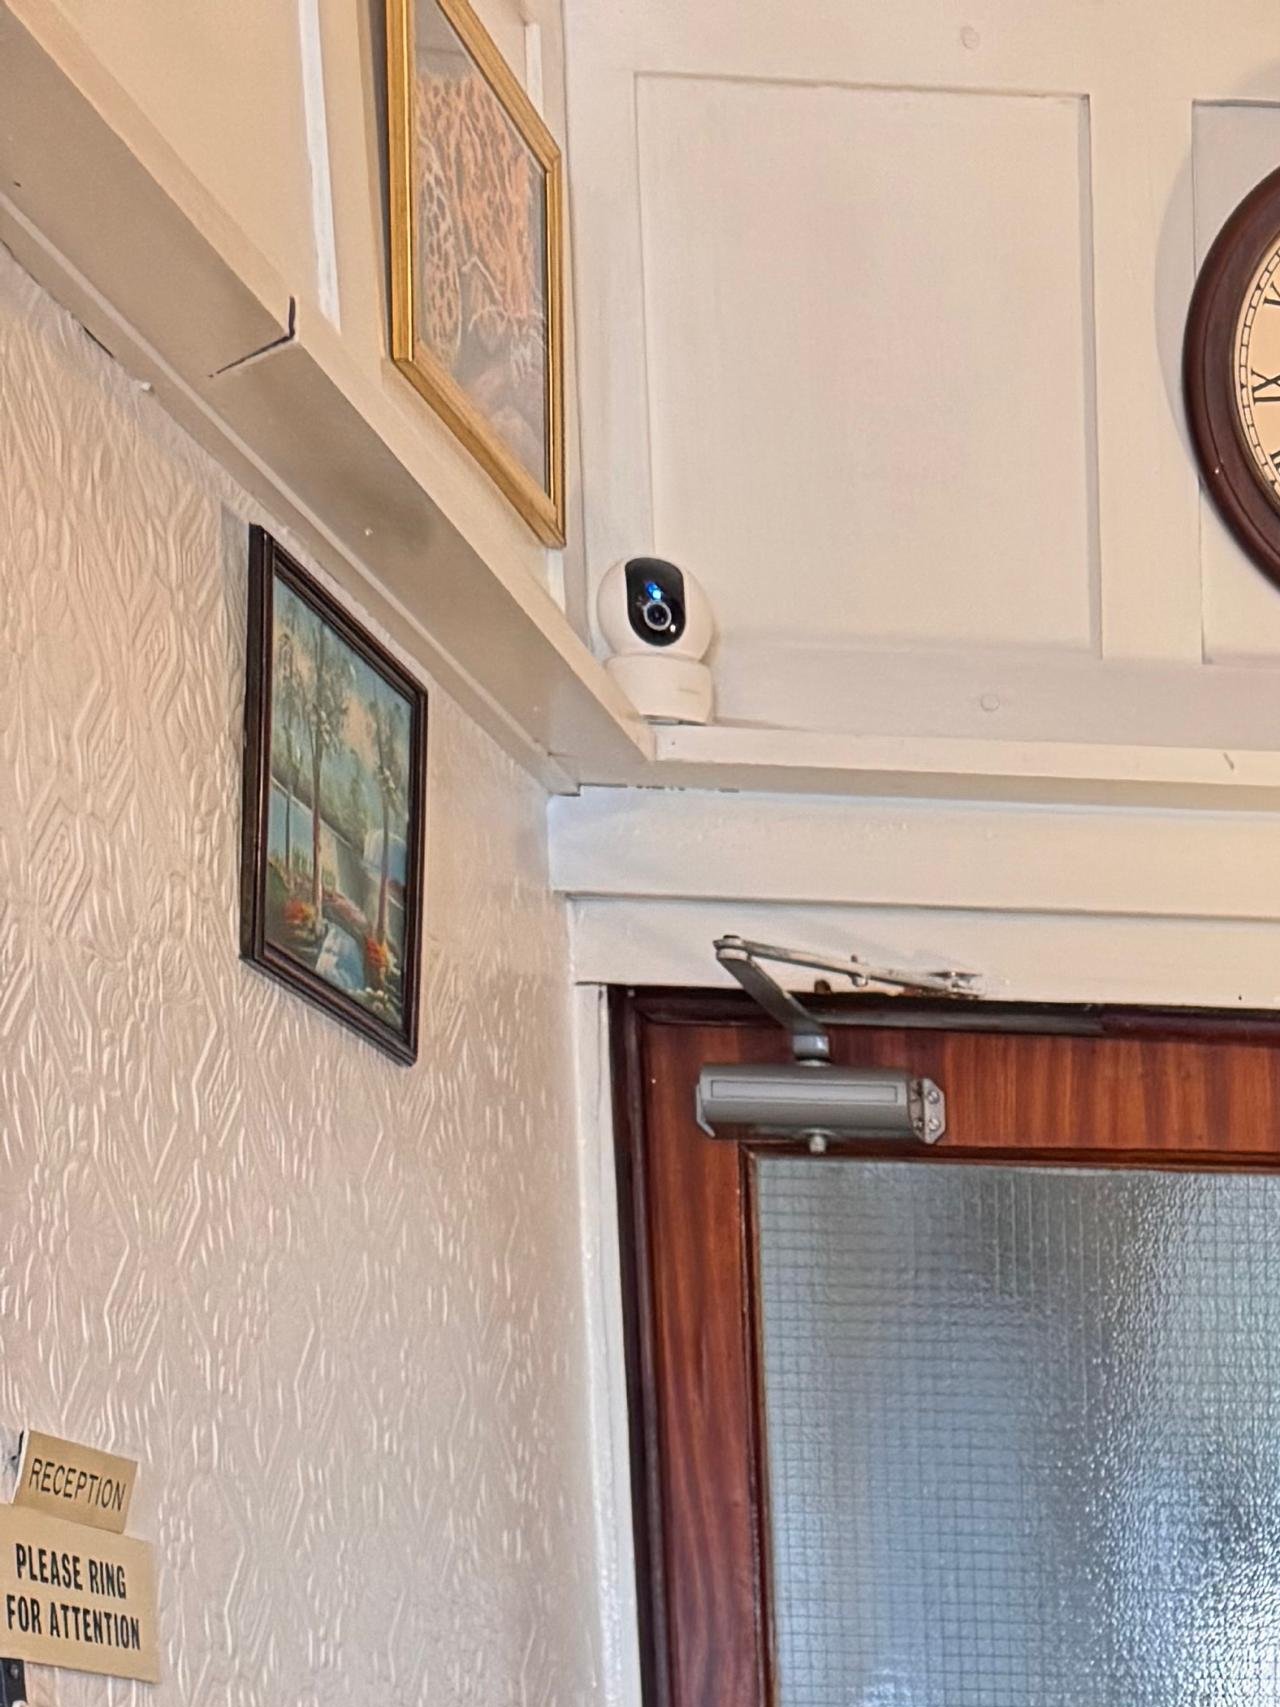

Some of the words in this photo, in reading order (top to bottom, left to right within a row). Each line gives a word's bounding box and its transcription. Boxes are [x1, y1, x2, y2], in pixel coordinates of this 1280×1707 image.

[29, 1458, 127, 1512] RECEPTION
[15, 1543, 83, 1591] PLEASE
[89, 1559, 127, 1599] RING
[6, 1594, 42, 1635] FOR
[50, 1602, 140, 1650] ATTENTION
